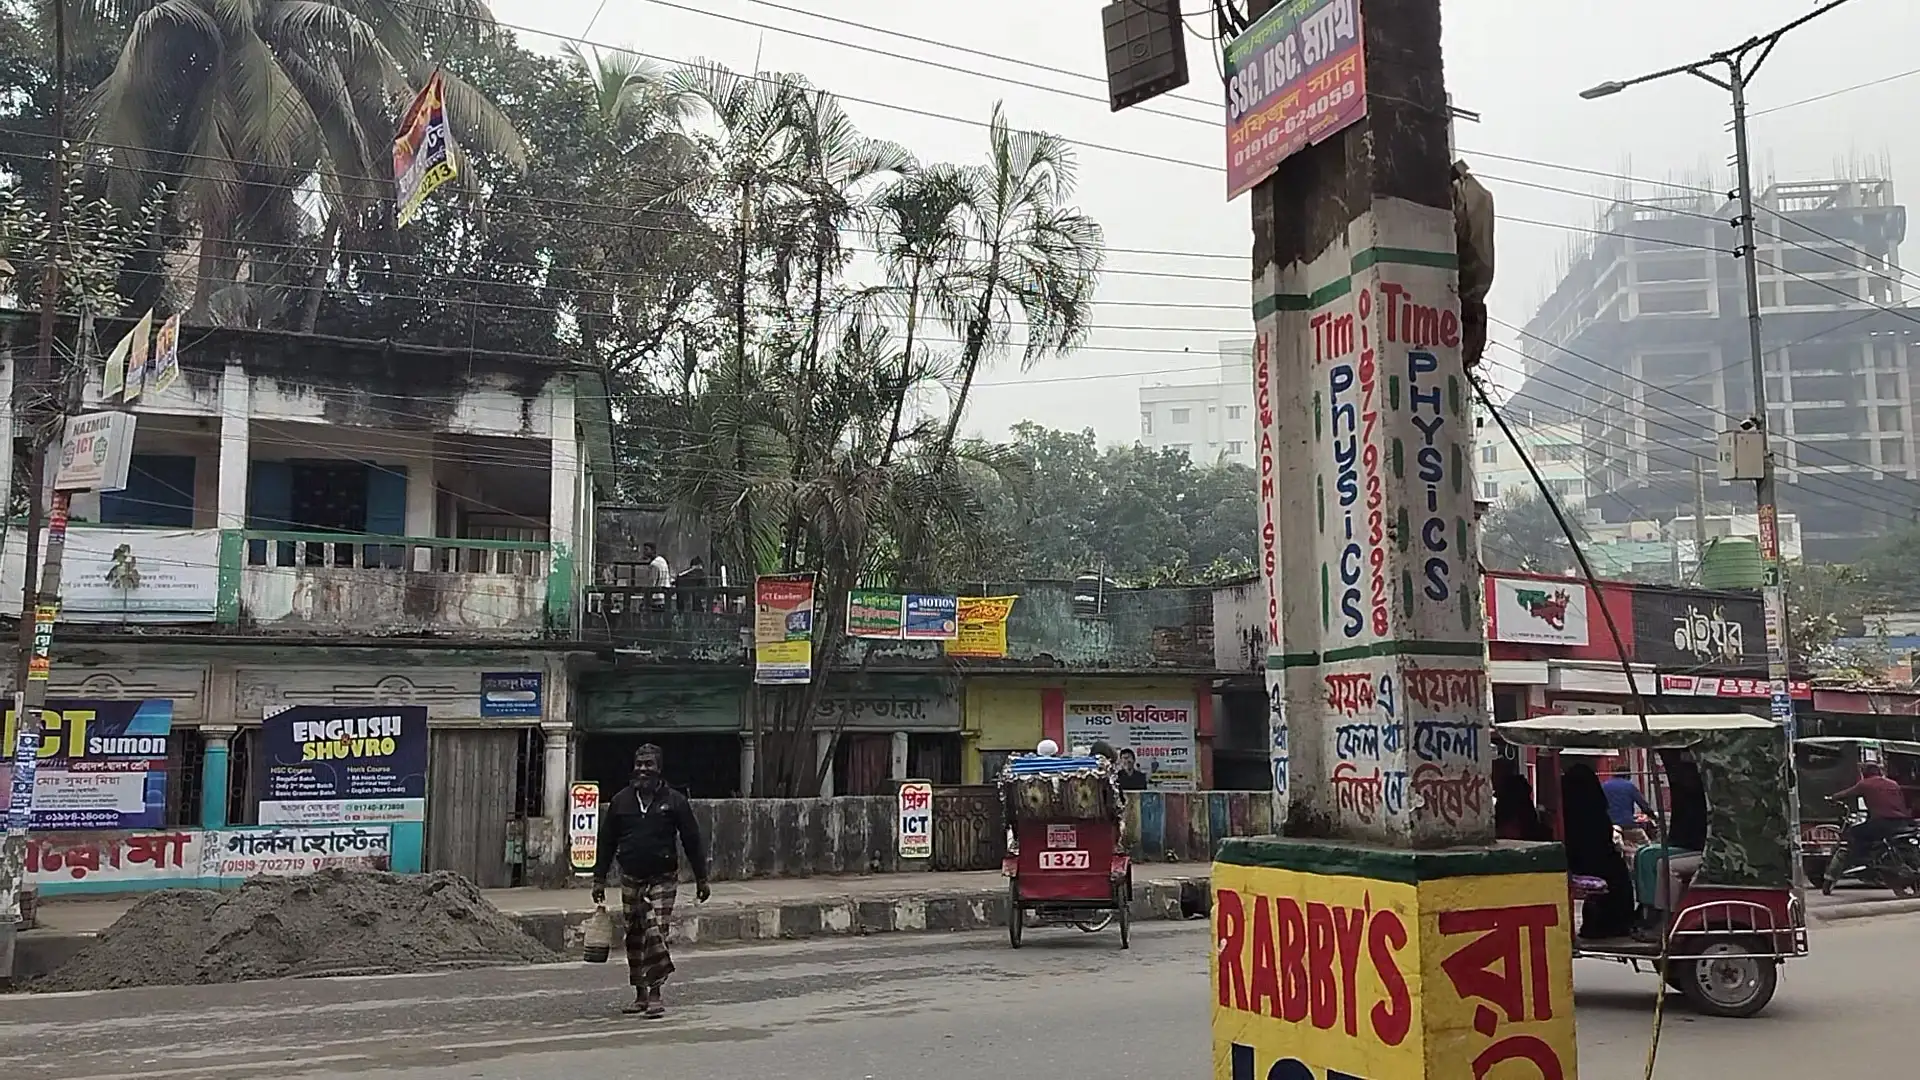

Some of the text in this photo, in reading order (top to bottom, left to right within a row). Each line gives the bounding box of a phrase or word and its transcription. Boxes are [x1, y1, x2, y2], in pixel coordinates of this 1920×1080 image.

[1229, 62, 1263, 119] SSC.
[1264, 34, 1301, 96] HSC.
[1306, 53, 1358, 93] স্যার
[1233, 80, 1356, 168] 01916-624059
[1380, 282, 1460, 348] Time
[73, 416, 111, 436] NAZMUL
[75, 436, 96, 454] ICT
[918, 598, 955, 608] MOTION
[1403, 669, 1486, 713] ময়লা
[1085, 716, 1112, 725] HSC
[1115, 705, 1188, 723] জীববিজ্ঞান
[292, 716, 402, 742] ENGLISH
[1412, 717, 1484, 763] ফেলা
[303, 737, 396, 761] SHUVRO
[1136, 747, 1170, 757] BIOLOGY
[572, 813, 596, 831] ICT
[902, 816, 929, 833] ICT
[300, 826, 390, 856] হোস্টেল
[1043, 852, 1088, 867] 1327
[1217, 888, 1412, 1047] RABBY'S
[1438, 903, 1558, 1038] রা
